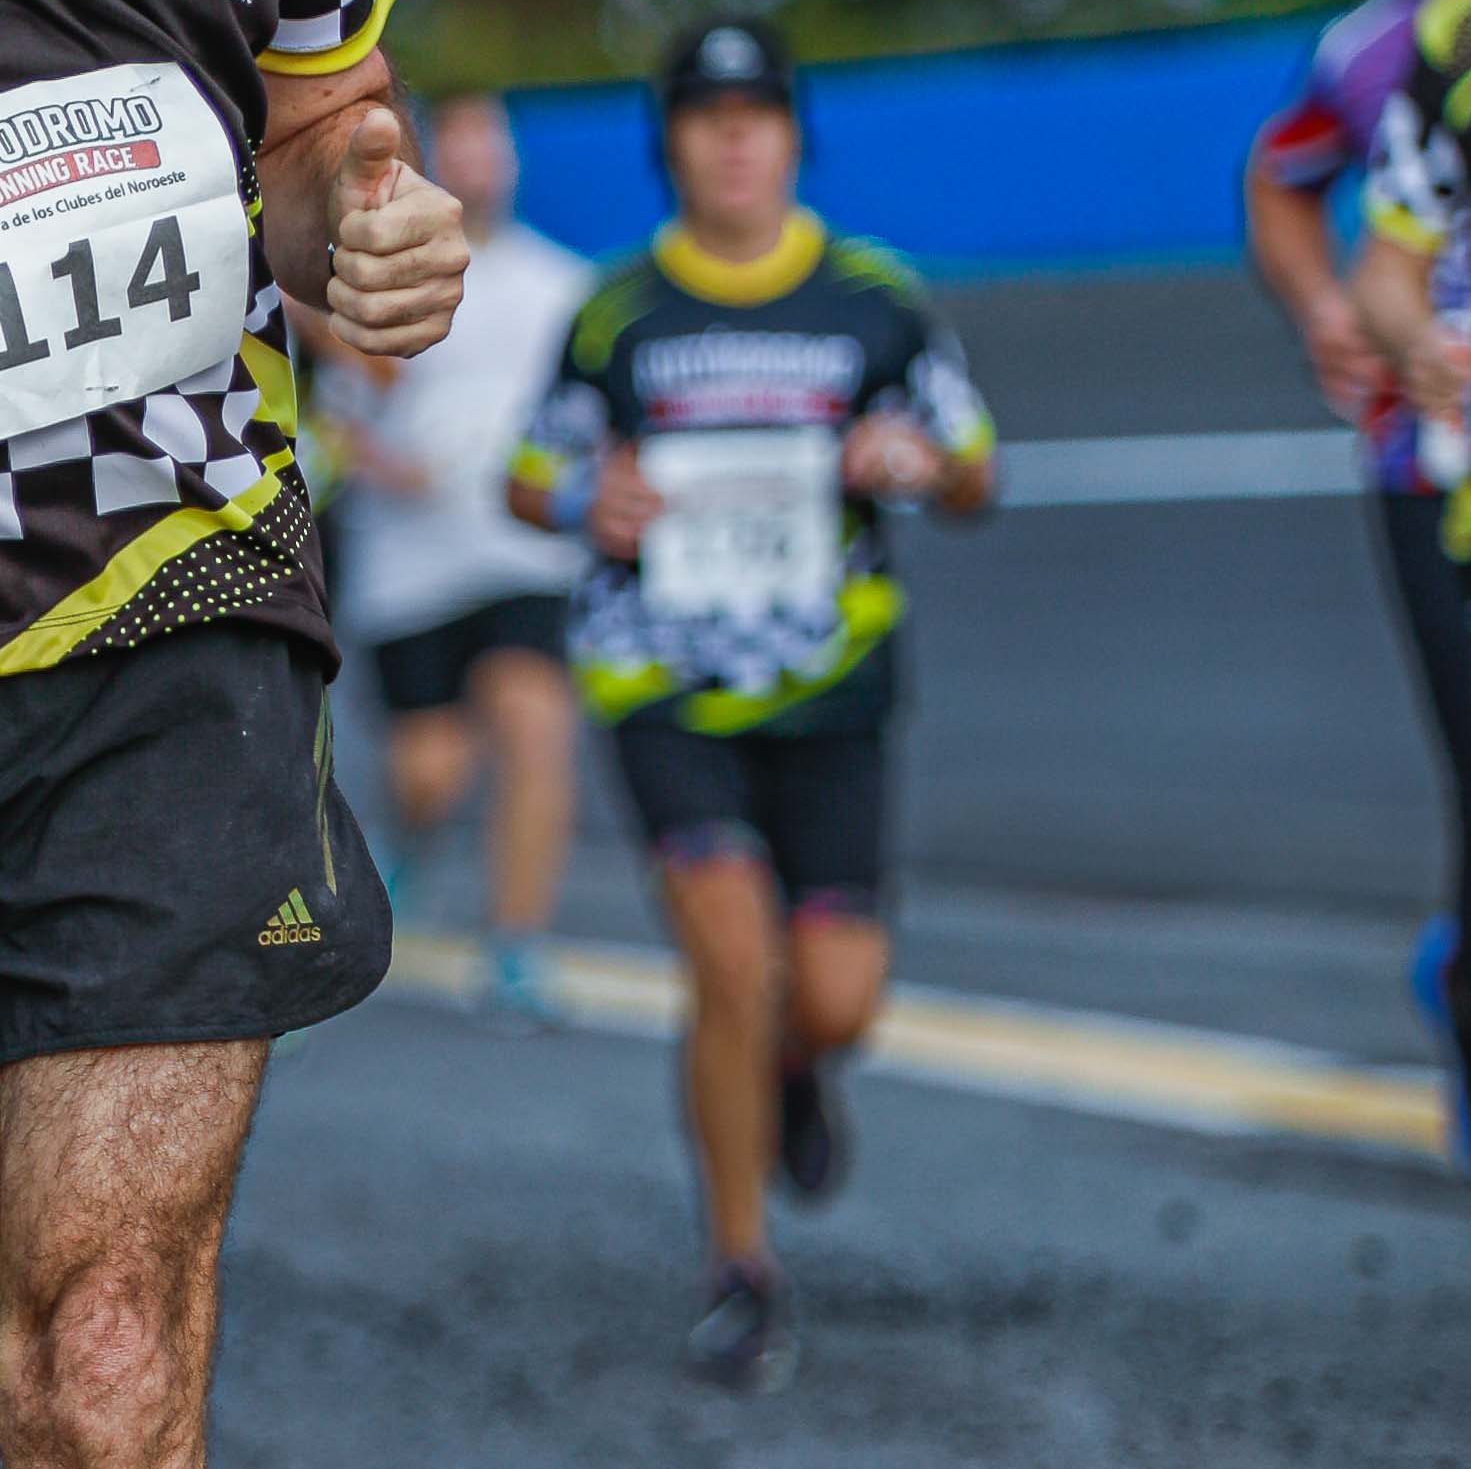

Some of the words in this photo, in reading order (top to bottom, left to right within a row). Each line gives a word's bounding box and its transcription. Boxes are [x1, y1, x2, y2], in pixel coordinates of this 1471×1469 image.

[73, 146, 137, 177] RACE
[12, 212, 31, 228] de
[31, 206, 54, 221] los
[55, 192, 103, 214] Clubes
[104, 183, 127, 201] del
[128, 170, 187, 195] Noroeste
[257, 924, 321, 946] adidas
